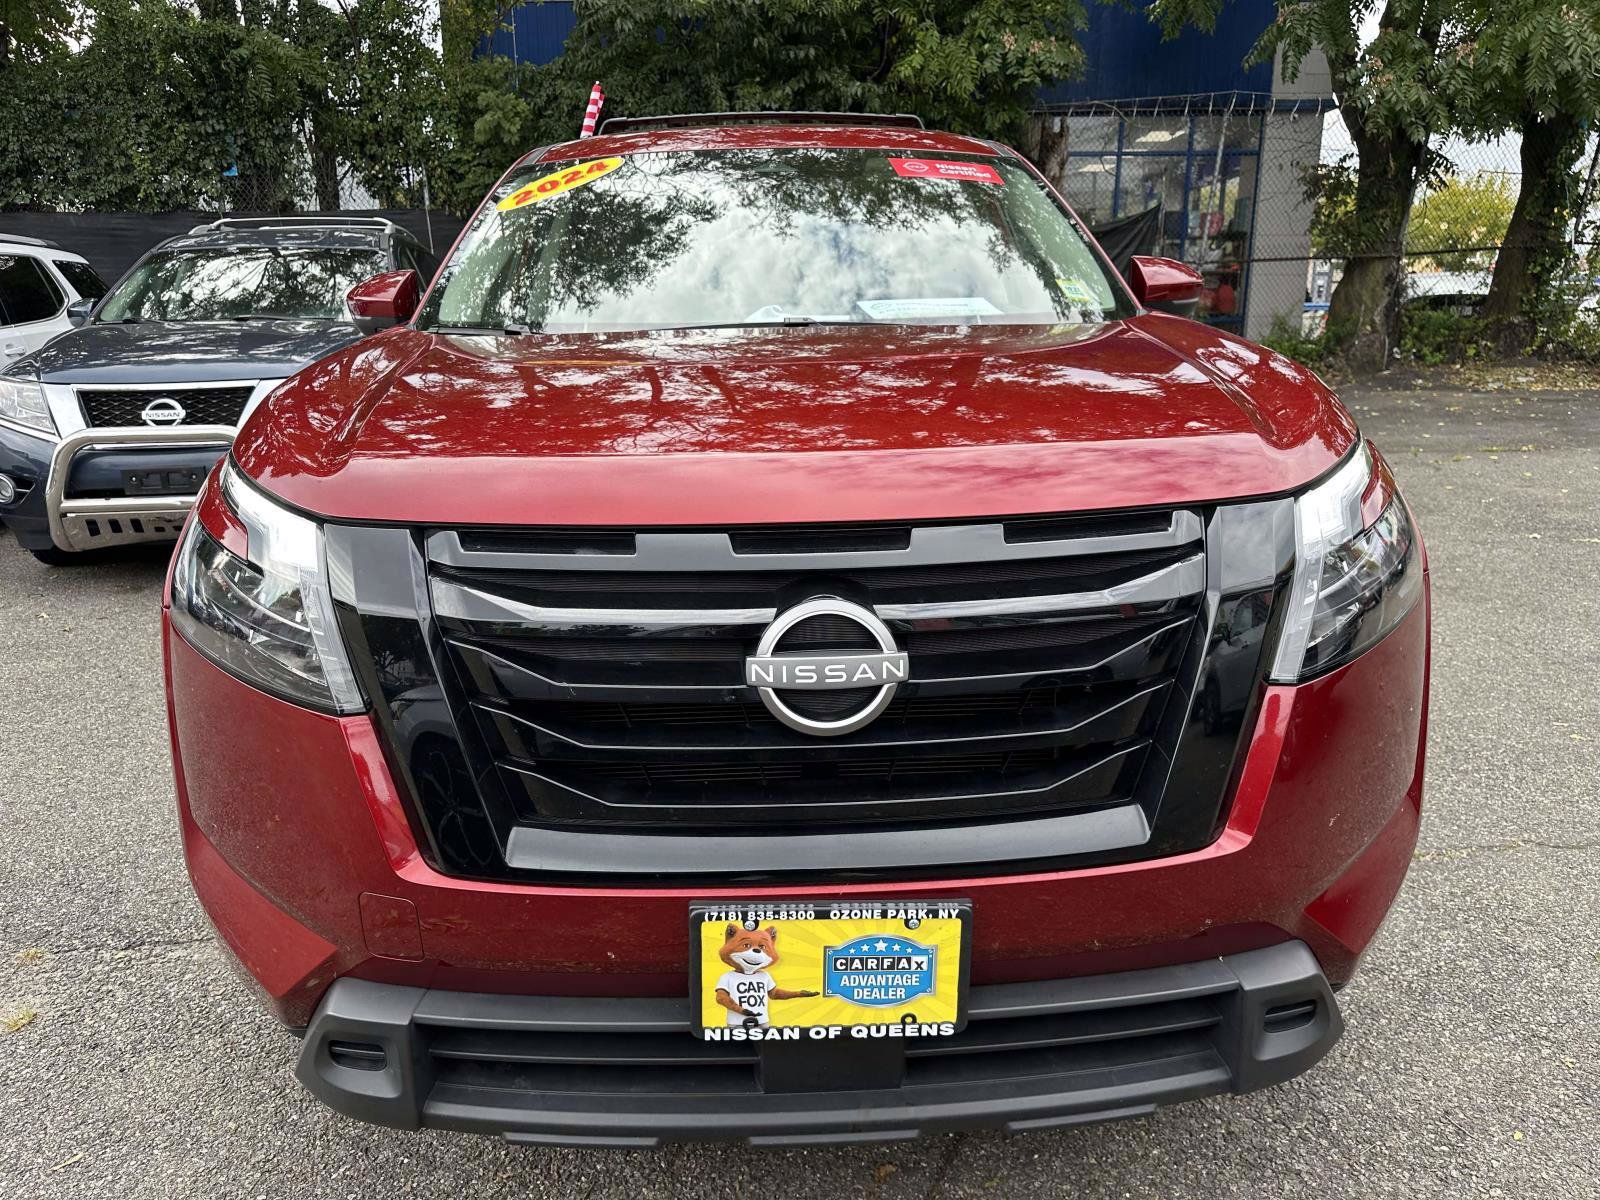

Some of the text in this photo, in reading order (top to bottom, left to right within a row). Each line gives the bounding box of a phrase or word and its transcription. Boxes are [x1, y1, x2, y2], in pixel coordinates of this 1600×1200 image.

[935, 163, 977, 172] Nissan
[939, 168, 992, 178] Certified
[512, 161, 608, 206] 2024
[751, 659, 904, 684] NISSAN
[704, 911, 742, 921] (718)
[829, 909, 882, 920] OZONE
[887, 909, 933, 920] PARK,
[938, 908, 960, 919] NY
[835, 957, 925, 971] CARFAX
[840, 974, 920, 986] ADVANTAGE
[736, 981, 765, 994] CAR
[853, 987, 906, 1000] DEALER
[738, 995, 765, 1007] FOX
[704, 1023, 955, 1041] NISSAN OF QUEENS
